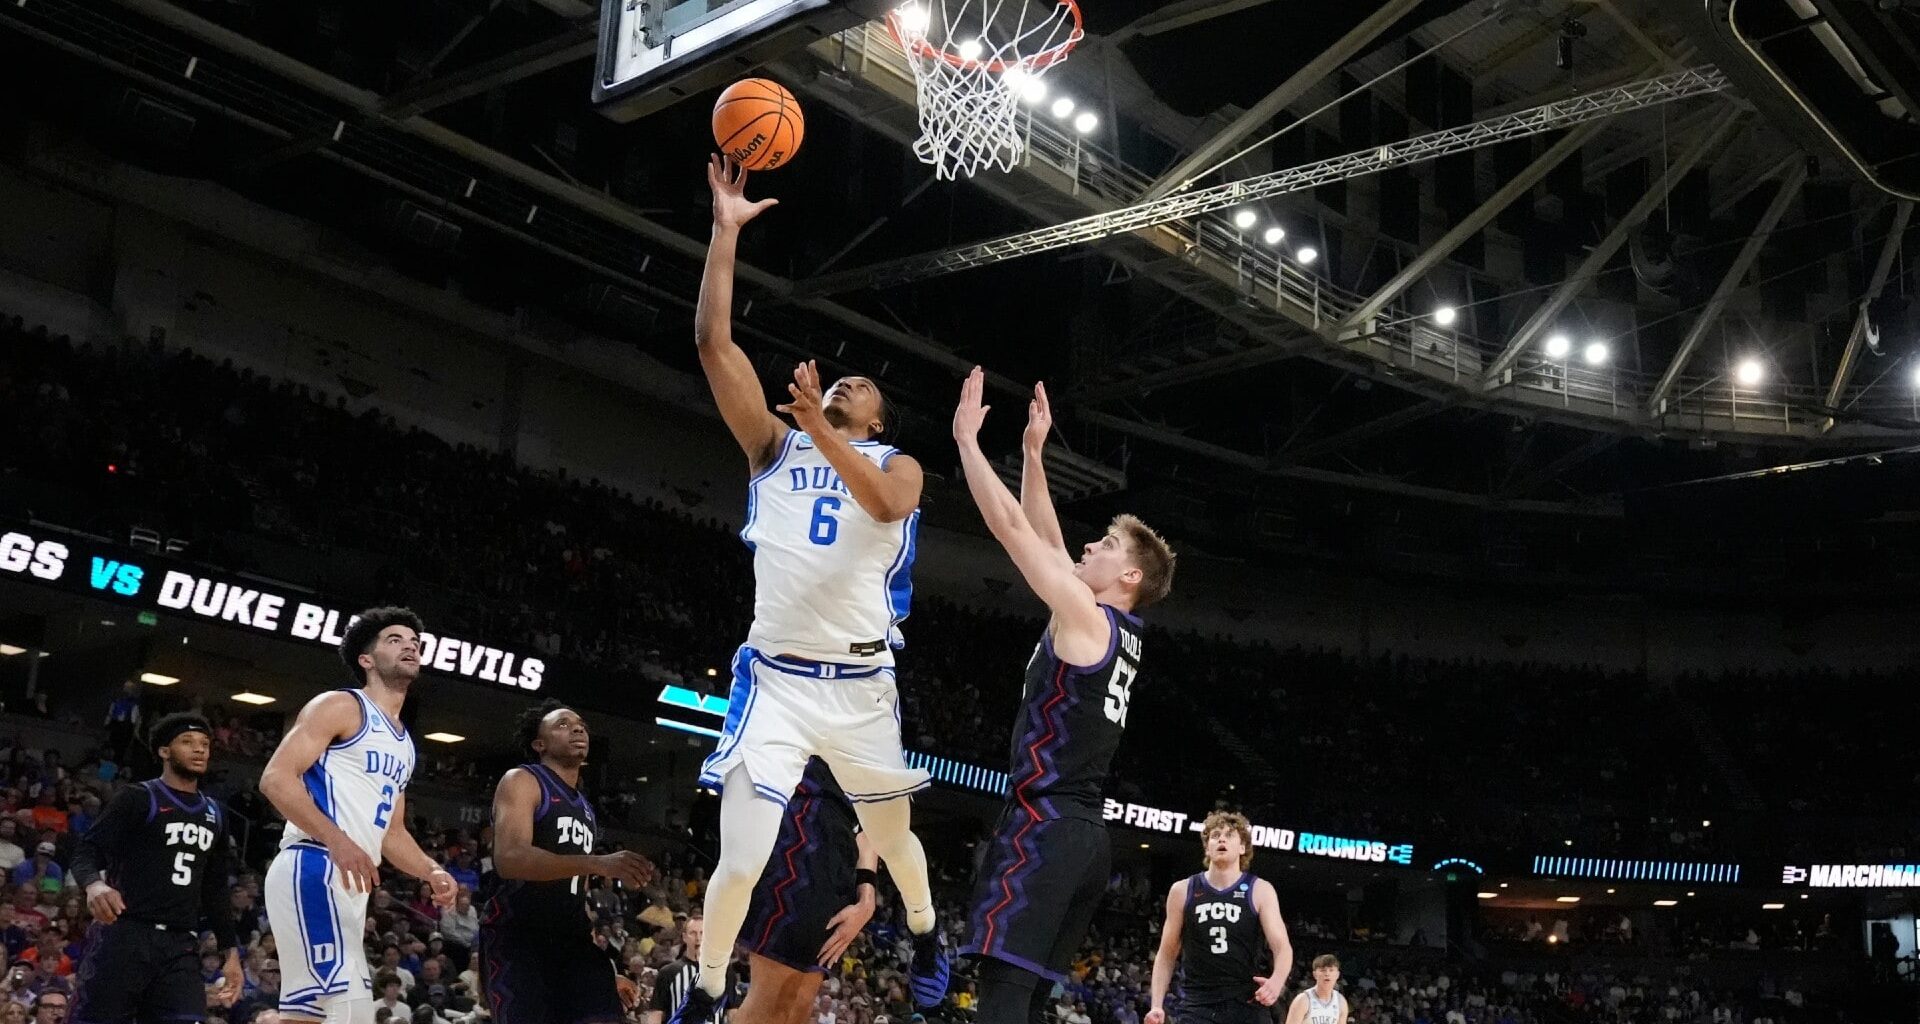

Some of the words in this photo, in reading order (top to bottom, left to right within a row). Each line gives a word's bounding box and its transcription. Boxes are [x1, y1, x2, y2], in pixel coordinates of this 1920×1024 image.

[730, 133, 767, 164] ilson
[790, 466, 850, 496] DUK
[809, 496, 841, 546] 6
[0, 532, 69, 580] GS
[90, 556, 144, 596] VS
[157, 570, 286, 631] DUKE
[291, 602, 361, 647] BL
[418, 632, 545, 691] DEVILS
[1119, 626, 1142, 662] TOOL
[1103, 656, 1138, 728] 55
[374, 785, 393, 829] 2
[165, 822, 214, 851] TCU
[557, 816, 593, 854] TCU
[1124, 803, 1188, 834] FIRST
[1248, 824, 1295, 850] OND
[1298, 832, 1388, 862] ROUNDS
[172, 852, 196, 886] 5
[1195, 902, 1242, 924] TCU
[312, 943, 335, 963] D
[1209, 926, 1228, 954] 3
